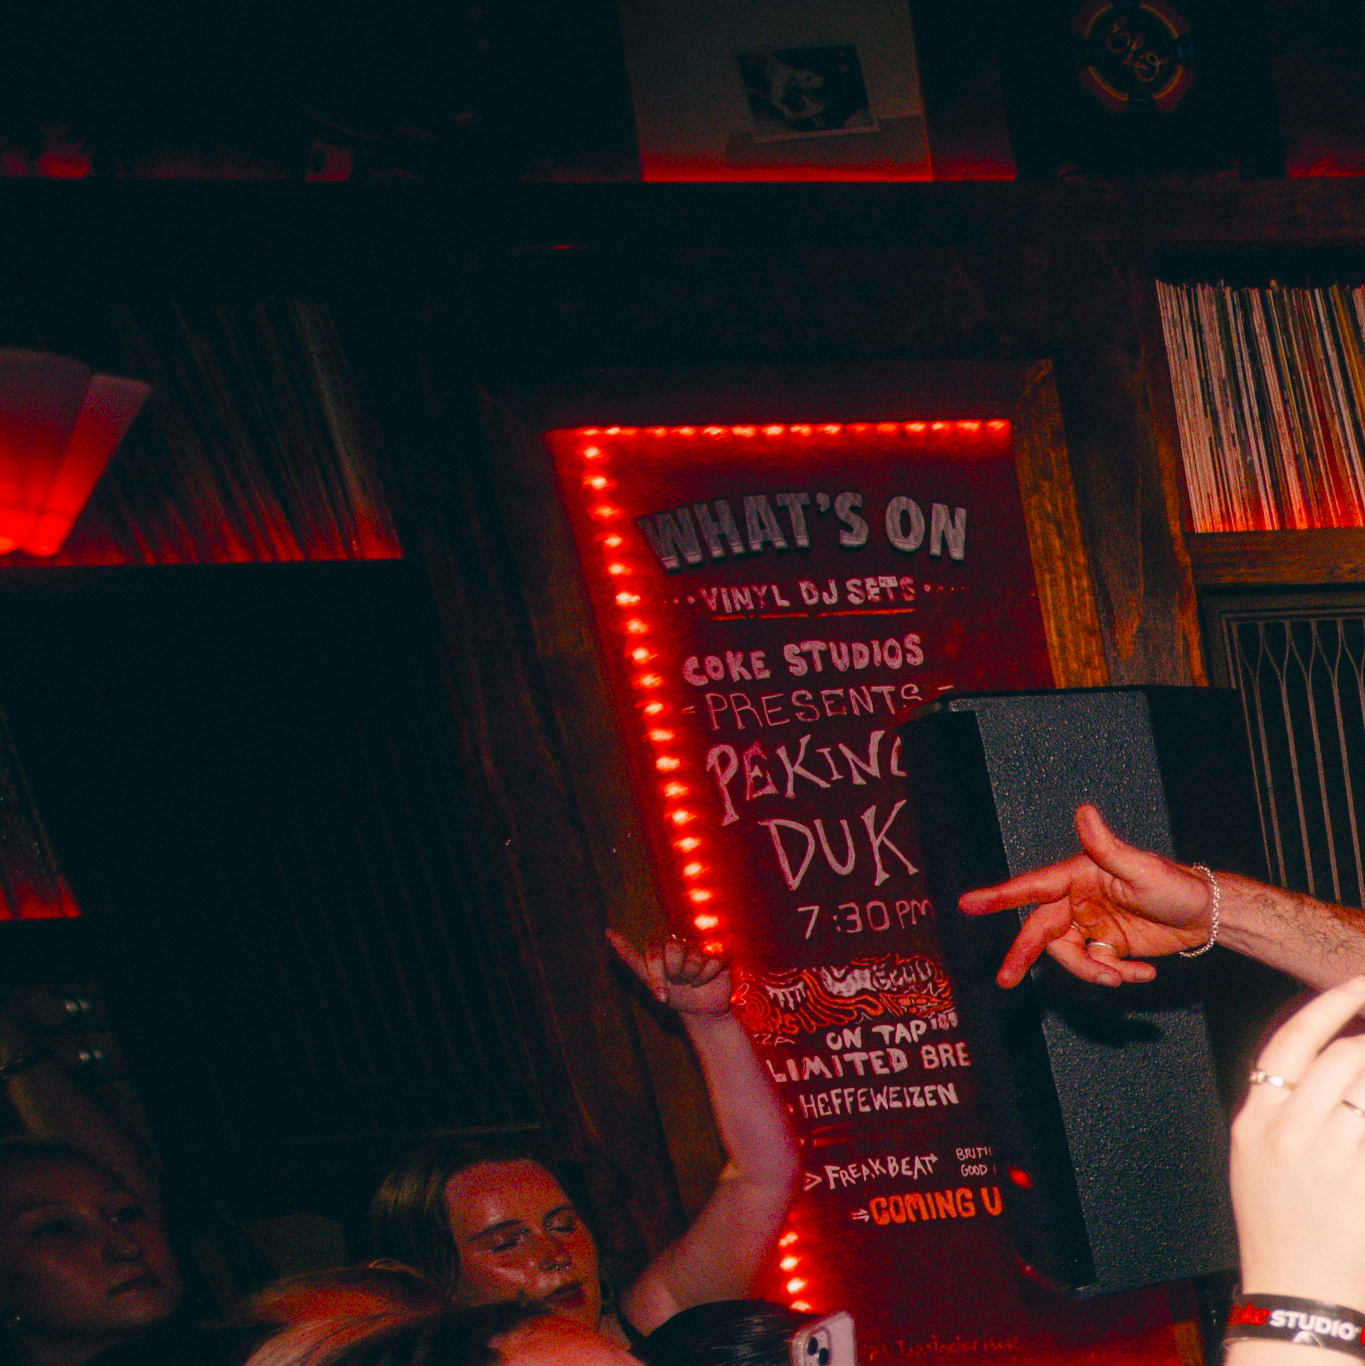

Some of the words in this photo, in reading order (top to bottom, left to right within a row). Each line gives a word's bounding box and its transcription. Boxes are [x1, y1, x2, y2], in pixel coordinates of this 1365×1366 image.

[634, 491, 869, 576] WHAT'S
[885, 495, 967, 562] ON
[700, 584, 790, 614] VINYL
[799, 578, 838, 605] DJ
[845, 575, 915, 605] SETS
[682, 650, 771, 687] COKE
[783, 633, 924, 677] STUDIOS
[705, 683, 922, 731] PRESENTS
[758, 799, 919, 891] DUK
[797, 900, 890, 940] 7:30
[895, 898, 936, 929] PM
[826, 1026, 863, 1051] ON
[872, 1019, 927, 1046] TAP
[766, 1047, 908, 1083] LIMITED
[920, 1042, 972, 1070] BRE
[960, 1164, 988, 1177] GOOD
[869, 1186, 976, 1226] COMING
[980, 1185, 1004, 1216] U
[1269, 1309, 1355, 1341] STUDIO
